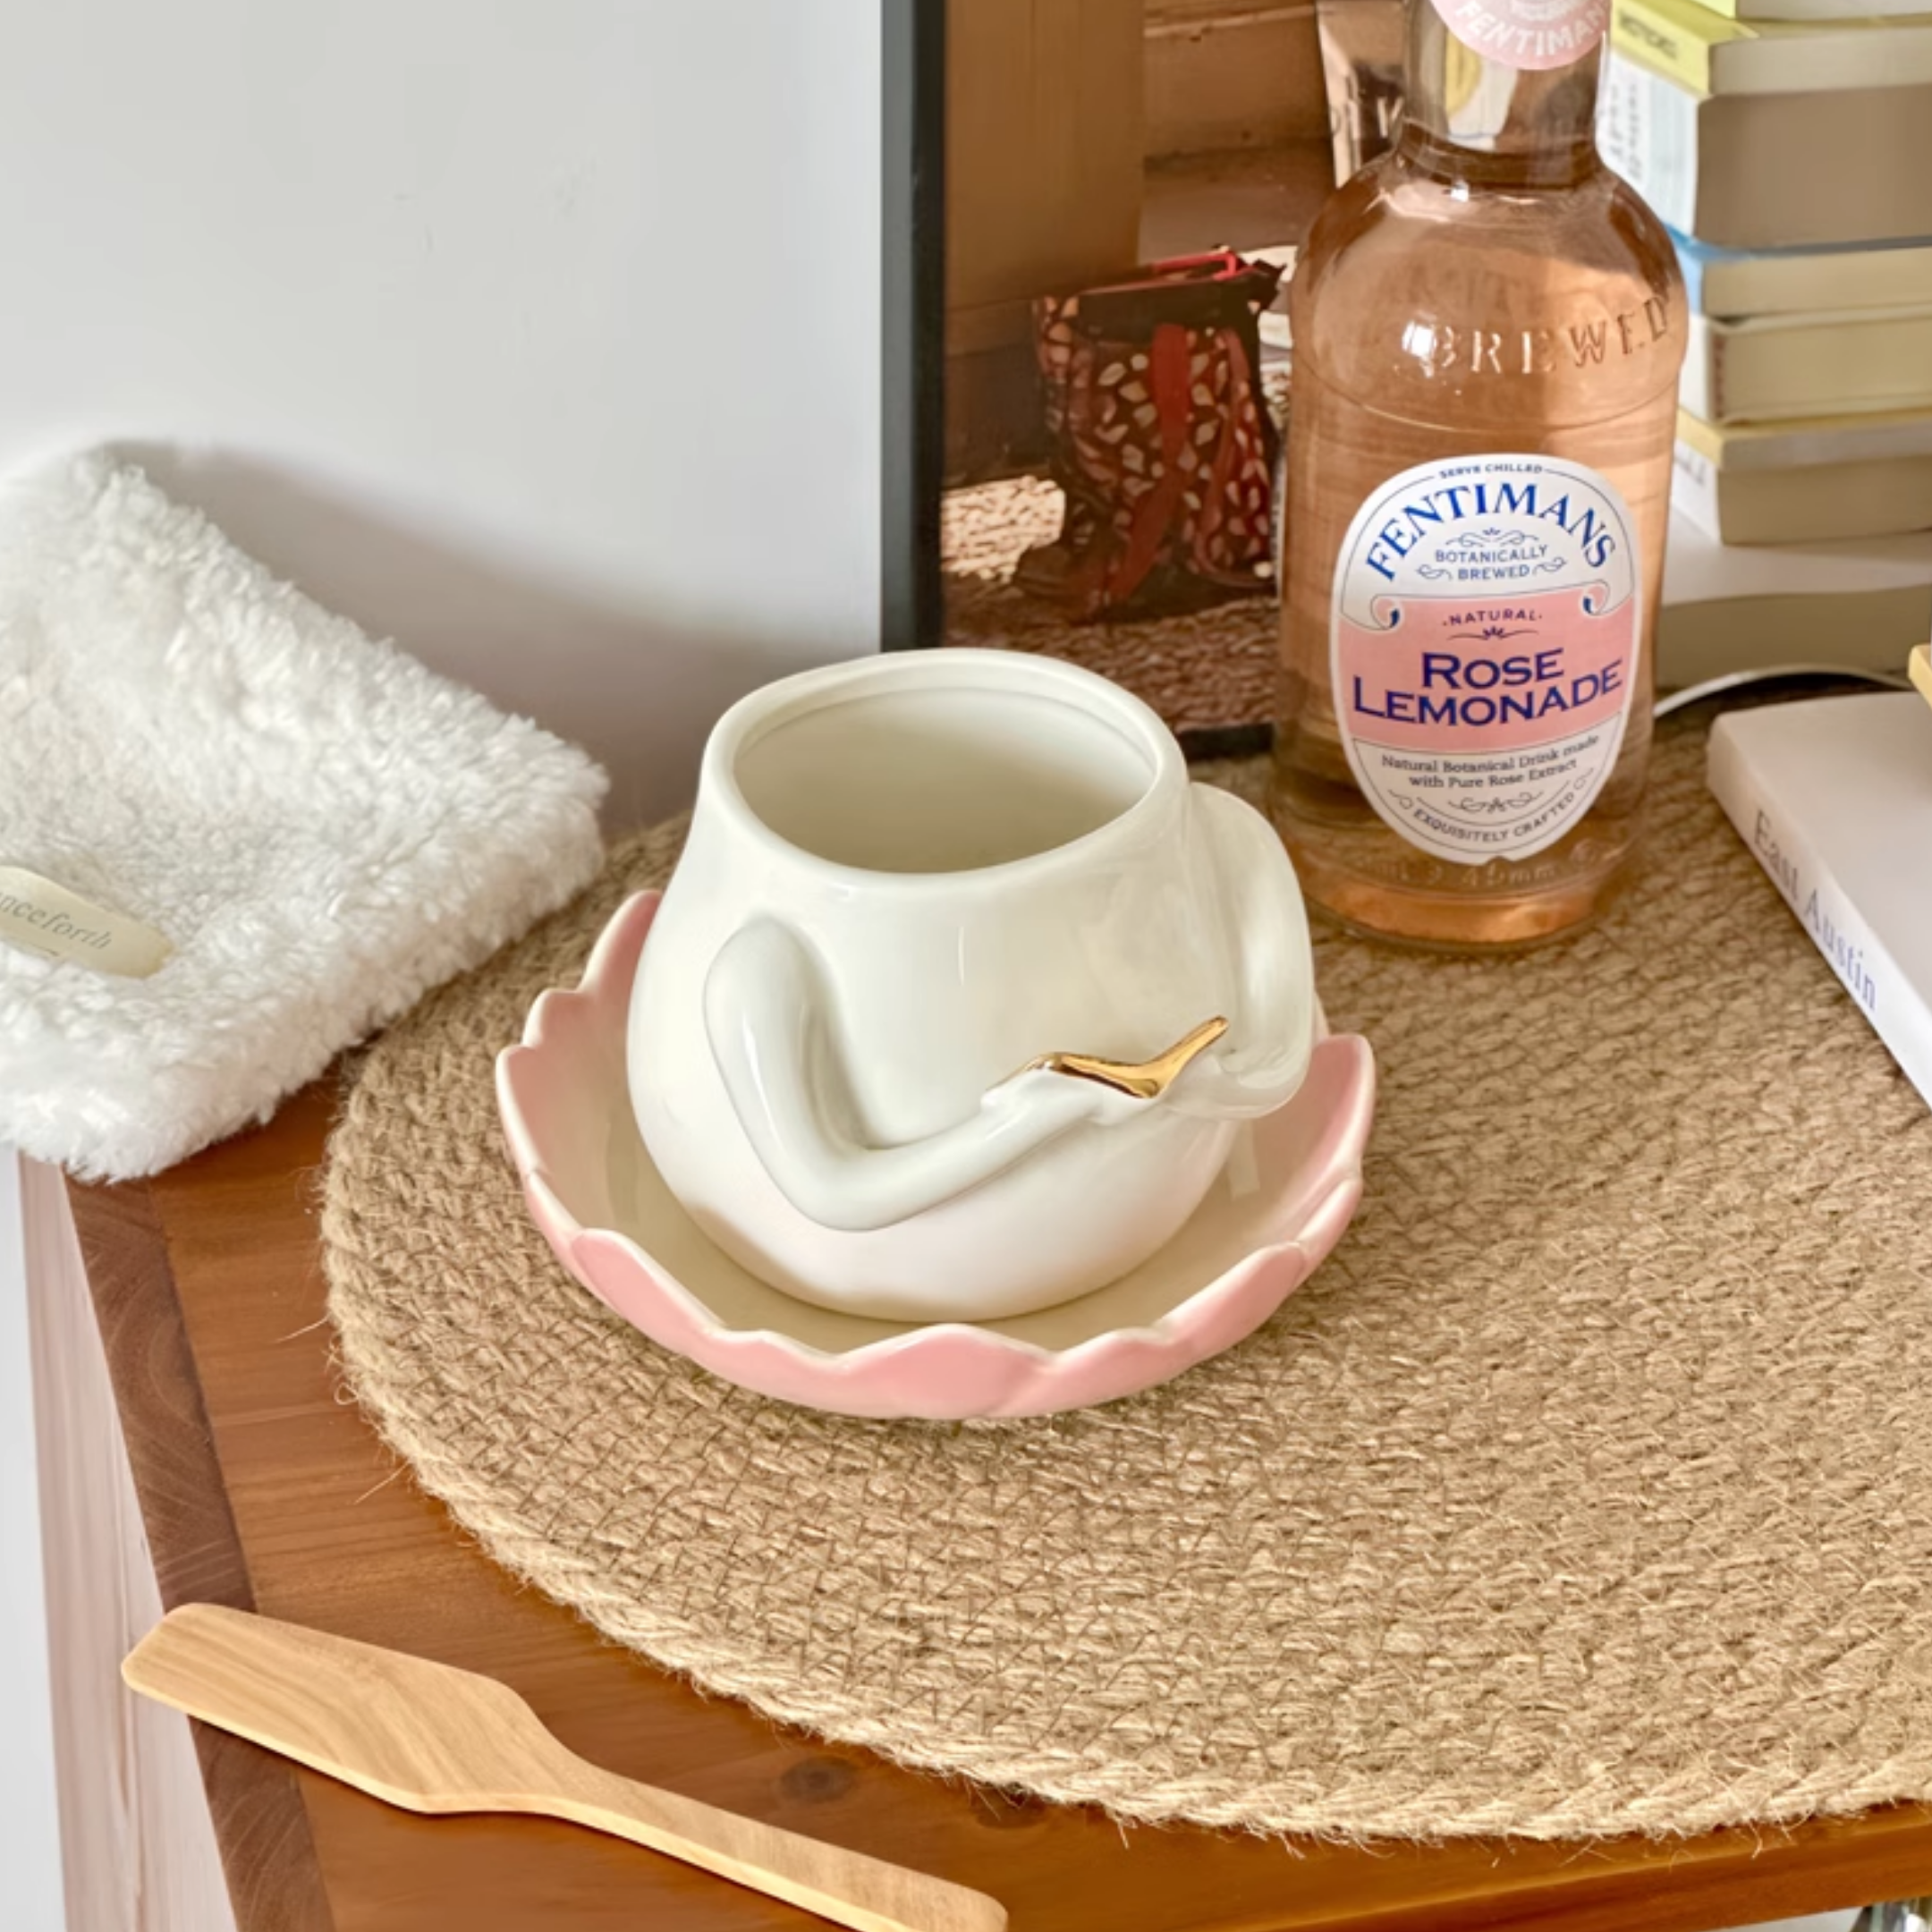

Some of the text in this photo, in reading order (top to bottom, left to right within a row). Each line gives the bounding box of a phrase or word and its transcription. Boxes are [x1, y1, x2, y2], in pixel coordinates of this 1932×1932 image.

[1455, 1, 1605, 56] FENTIMAN
[1438, 463, 1543, 479] SERVE CHILLED
[1366, 481, 1617, 581] FENTIMANS
[1435, 545, 1548, 564] BOTANICALLY
[1457, 564, 1530, 580] BREWED
[1353, 658, 1623, 726] LEMONADE
[1421, 648, 1564, 690] ROSE
[1382, 735, 1599, 774] Natural Botanical Drink made
[1409, 758, 1577, 788] with Pure Rose Extract
[1413, 792, 1575, 843] EXQUISITELY CRAFTED
[0, 892, 112, 949] nceforth
[1804, 888, 1876, 1012] Austin
